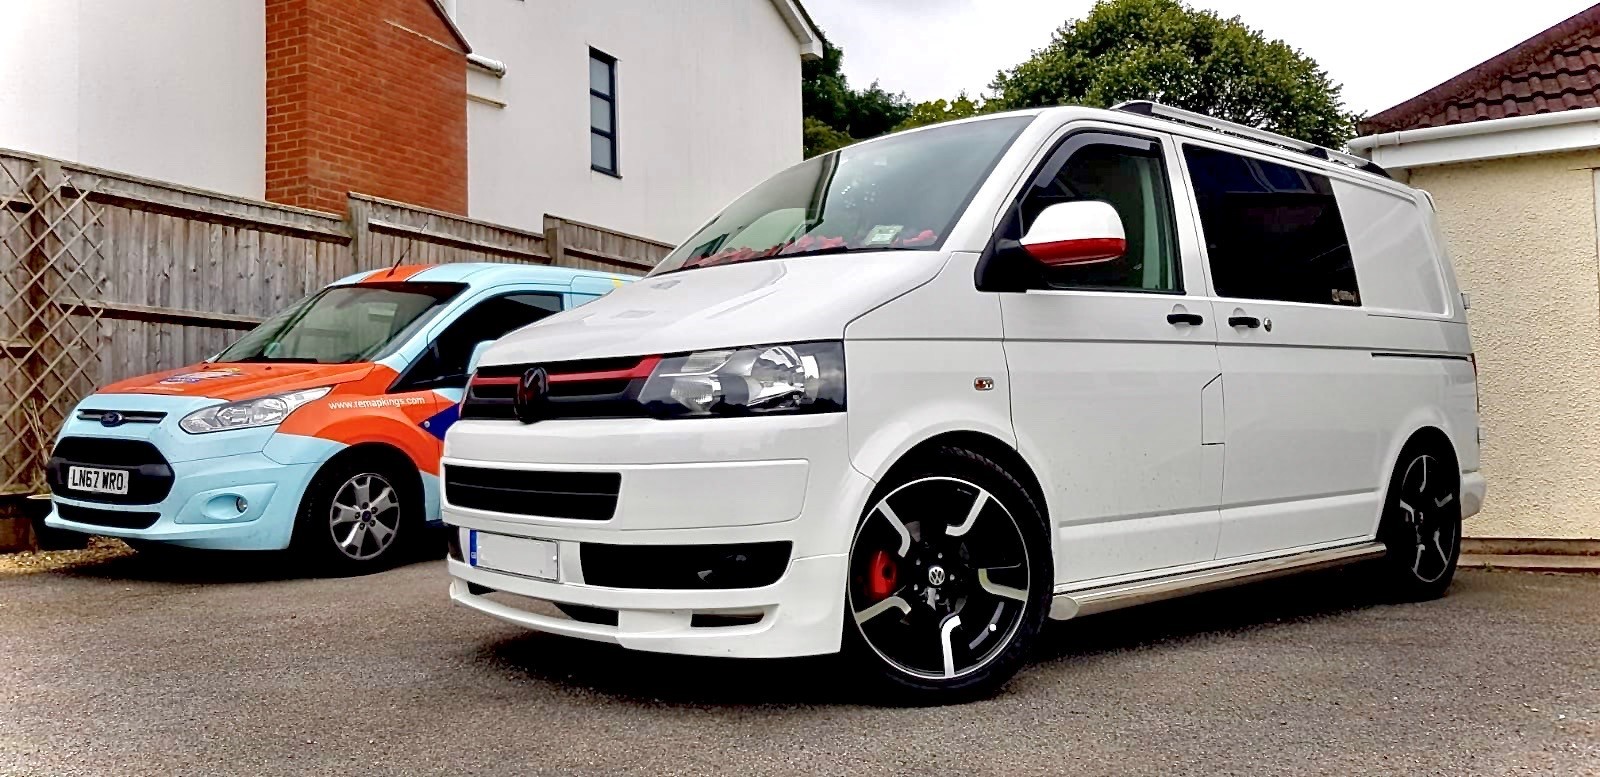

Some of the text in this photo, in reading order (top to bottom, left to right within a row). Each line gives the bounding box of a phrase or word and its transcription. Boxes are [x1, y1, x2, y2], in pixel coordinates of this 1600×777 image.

[328, 397, 425, 409] www.remapkings.com
[72, 469, 124, 491] LN67 WRO
